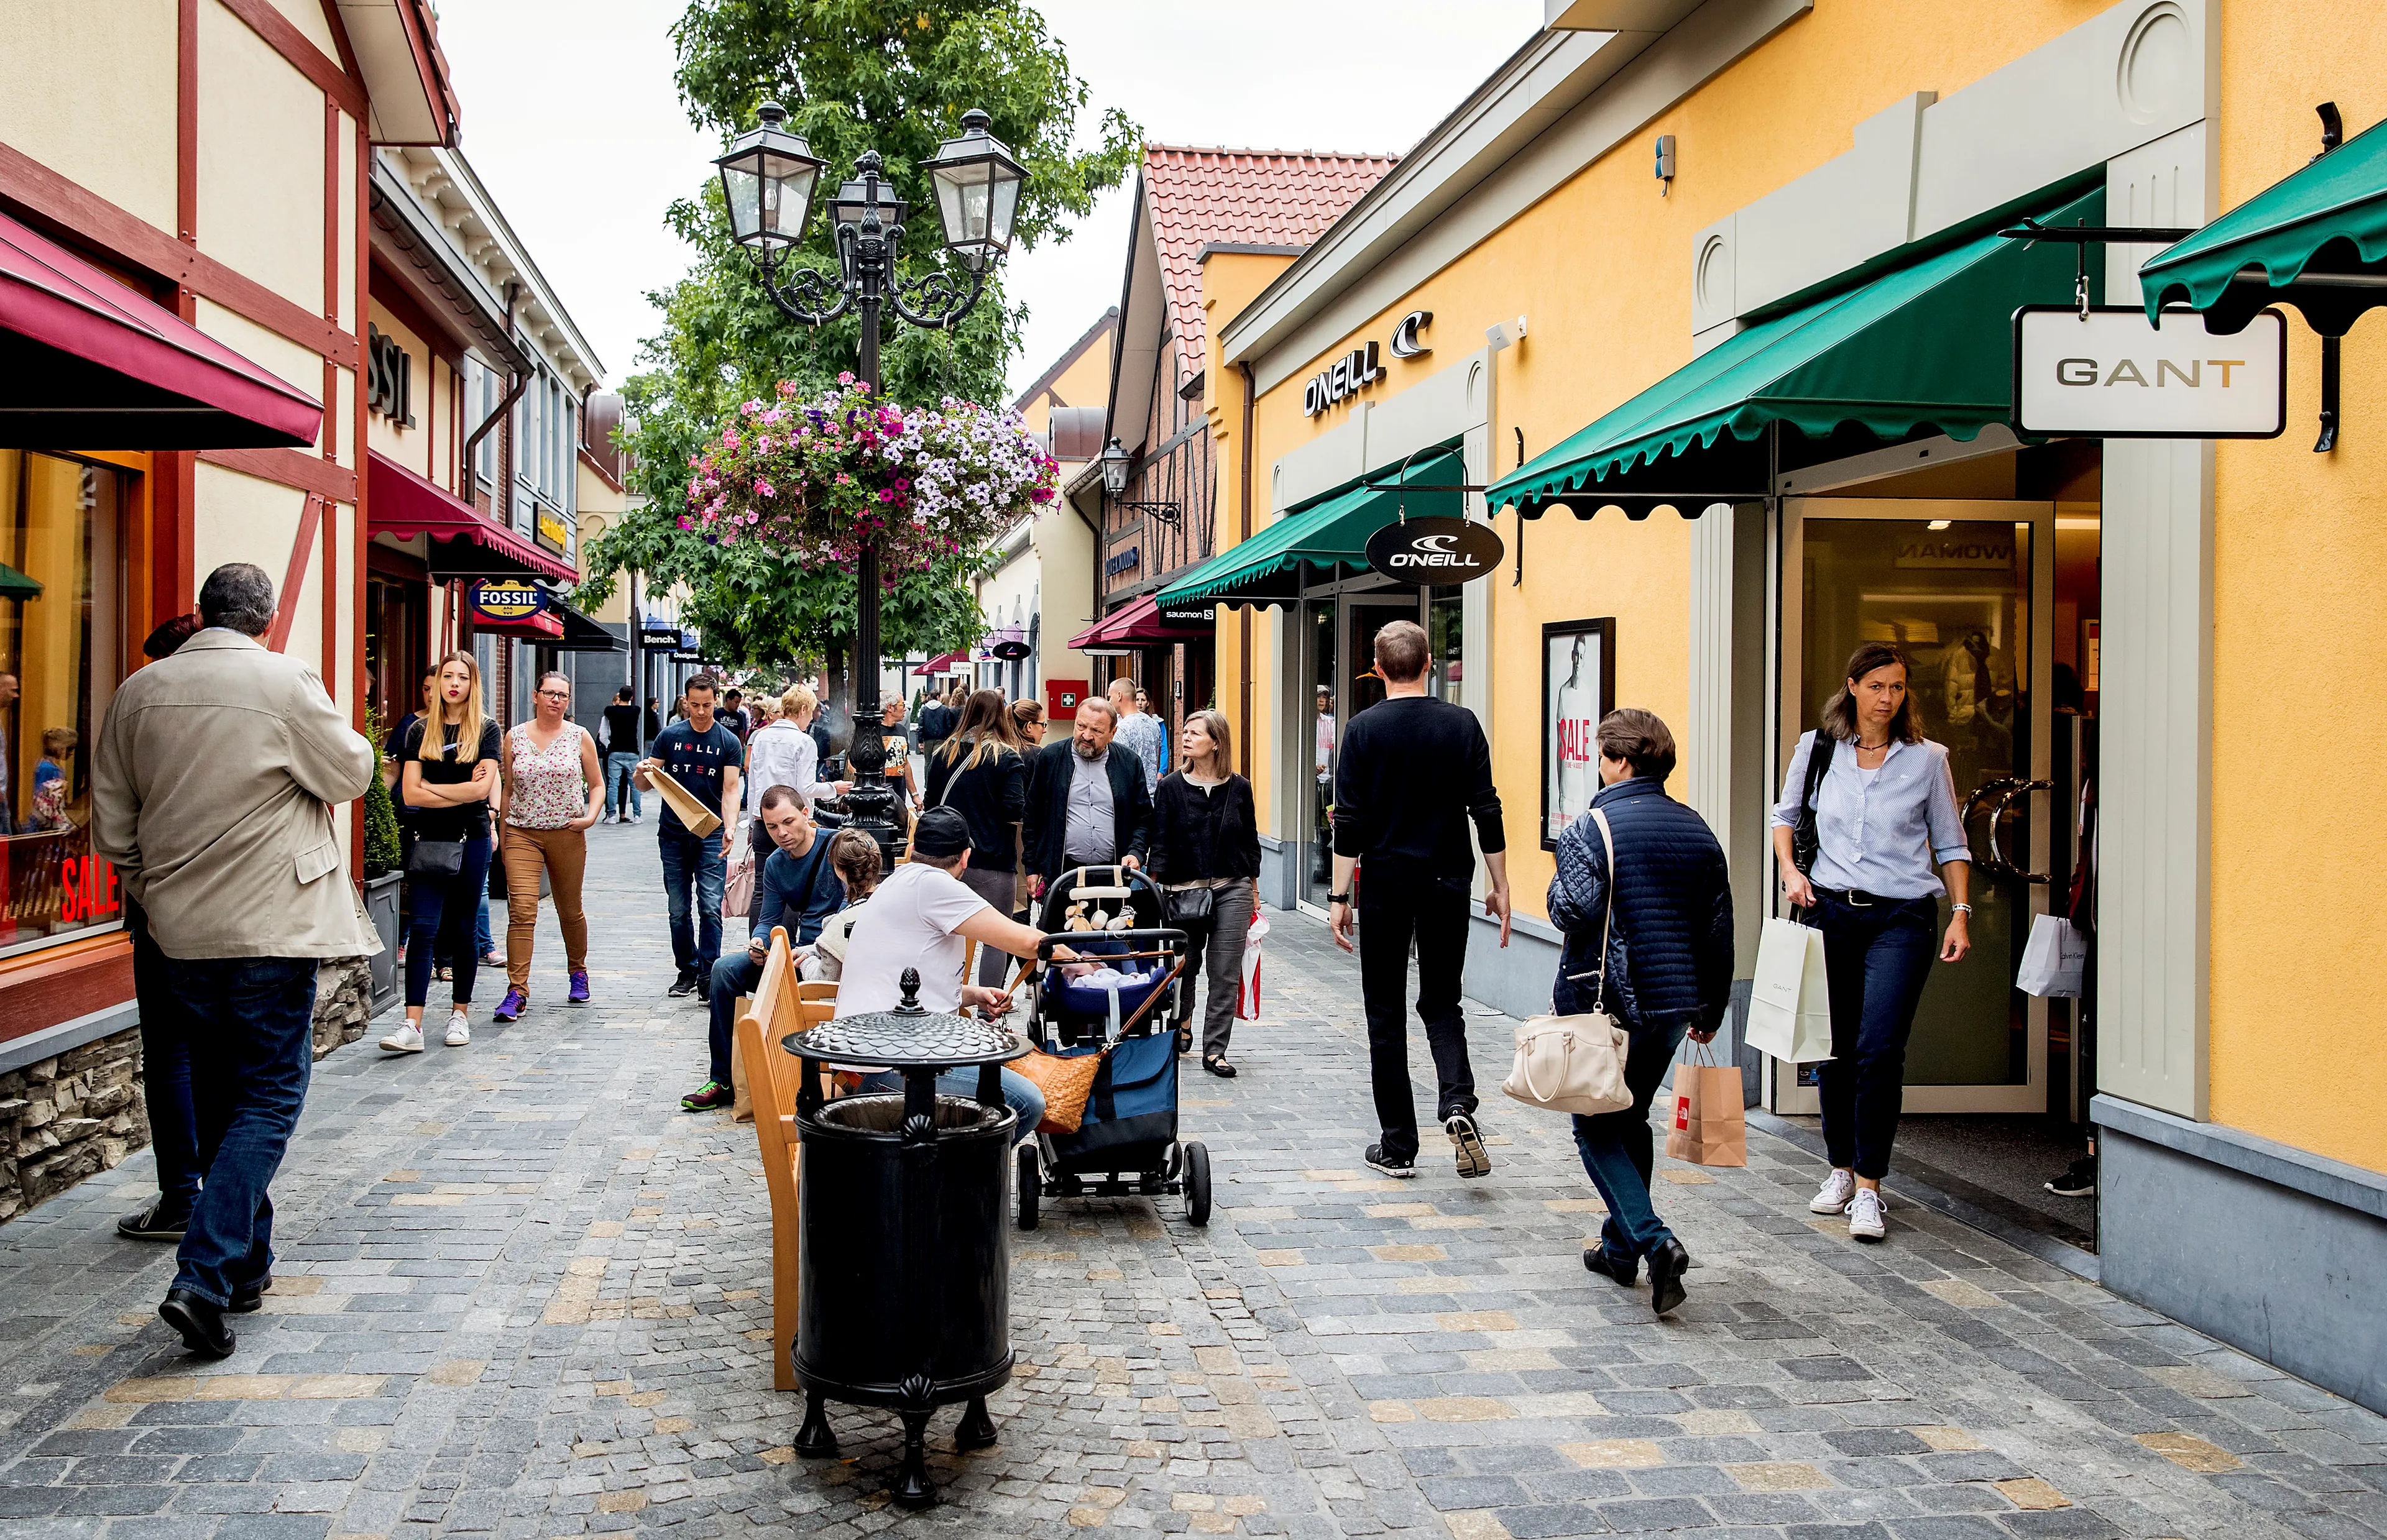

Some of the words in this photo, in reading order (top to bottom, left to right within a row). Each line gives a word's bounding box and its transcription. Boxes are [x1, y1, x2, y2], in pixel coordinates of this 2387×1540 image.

[1304, 341, 1387, 418] O'NEILL
[2056, 358, 2245, 387] GANT
[1389, 554, 1480, 567] O'NEILL
[479, 592, 537, 604] FOSSIL
[644, 635, 676, 643] Bench.
[1559, 718, 1590, 762] SALE
[62, 853, 119, 923] SALE
[1773, 983, 1791, 993] GANT
